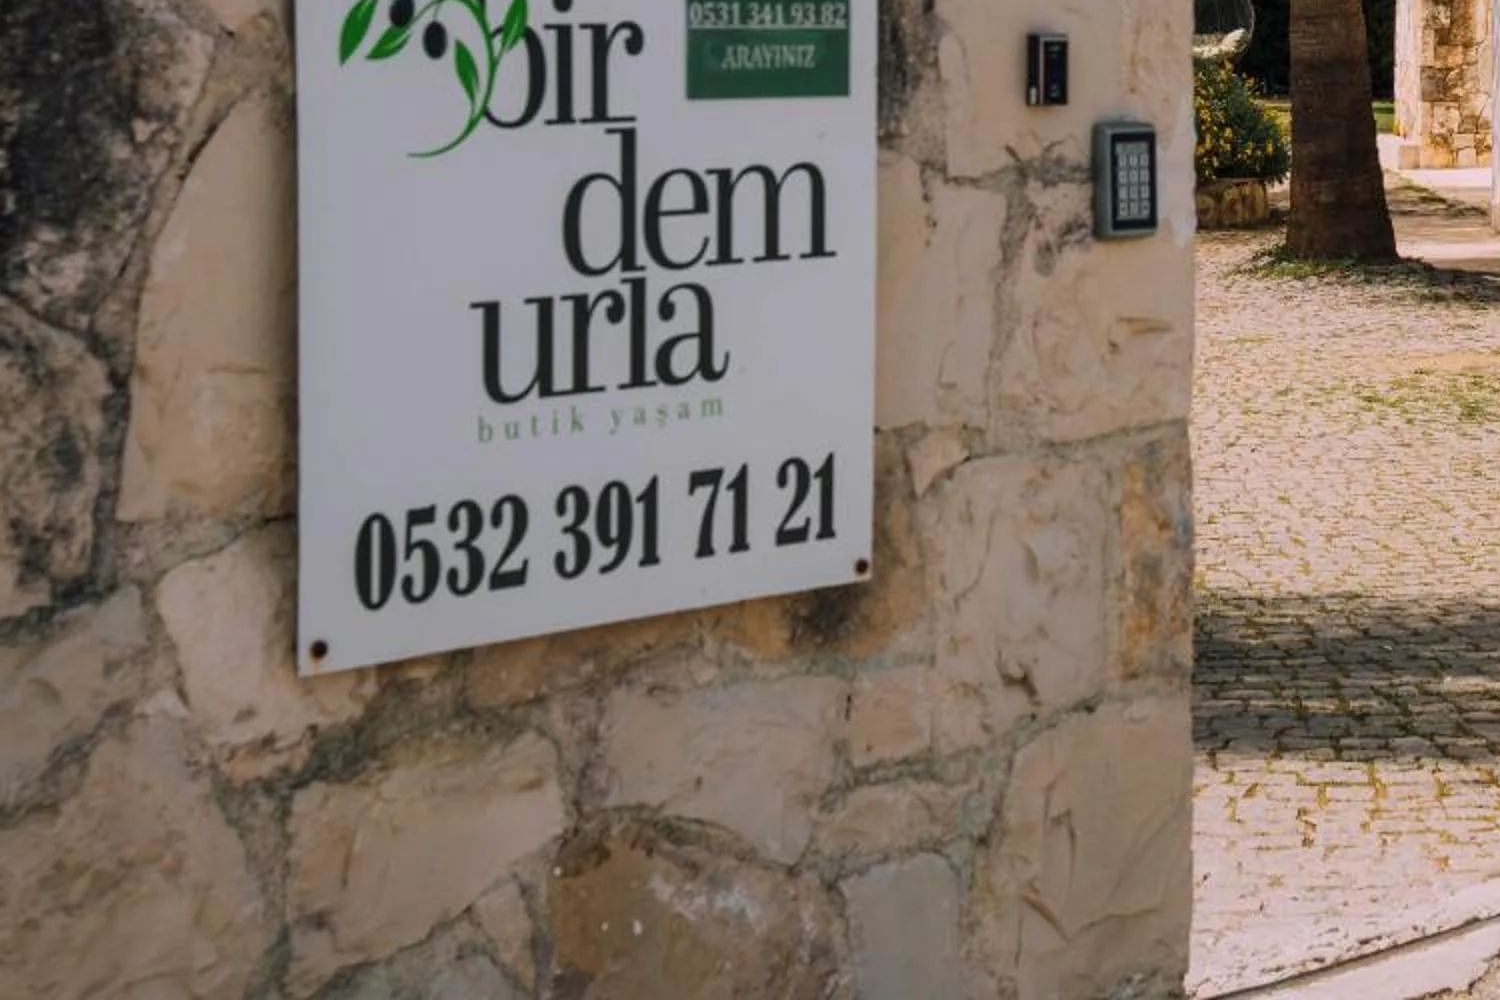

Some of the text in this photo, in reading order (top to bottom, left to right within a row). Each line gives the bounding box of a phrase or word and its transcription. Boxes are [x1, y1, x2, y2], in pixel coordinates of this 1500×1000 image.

[689, 0, 847, 28] 0531 341 93 82
[720, 44, 816, 70] ARAYINIZ
[562, 128, 837, 277] dem
[469, 277, 730, 404] urla
[477, 397, 723, 443] butik yaşam
[354, 452, 837, 612] 0532 391 71 21
